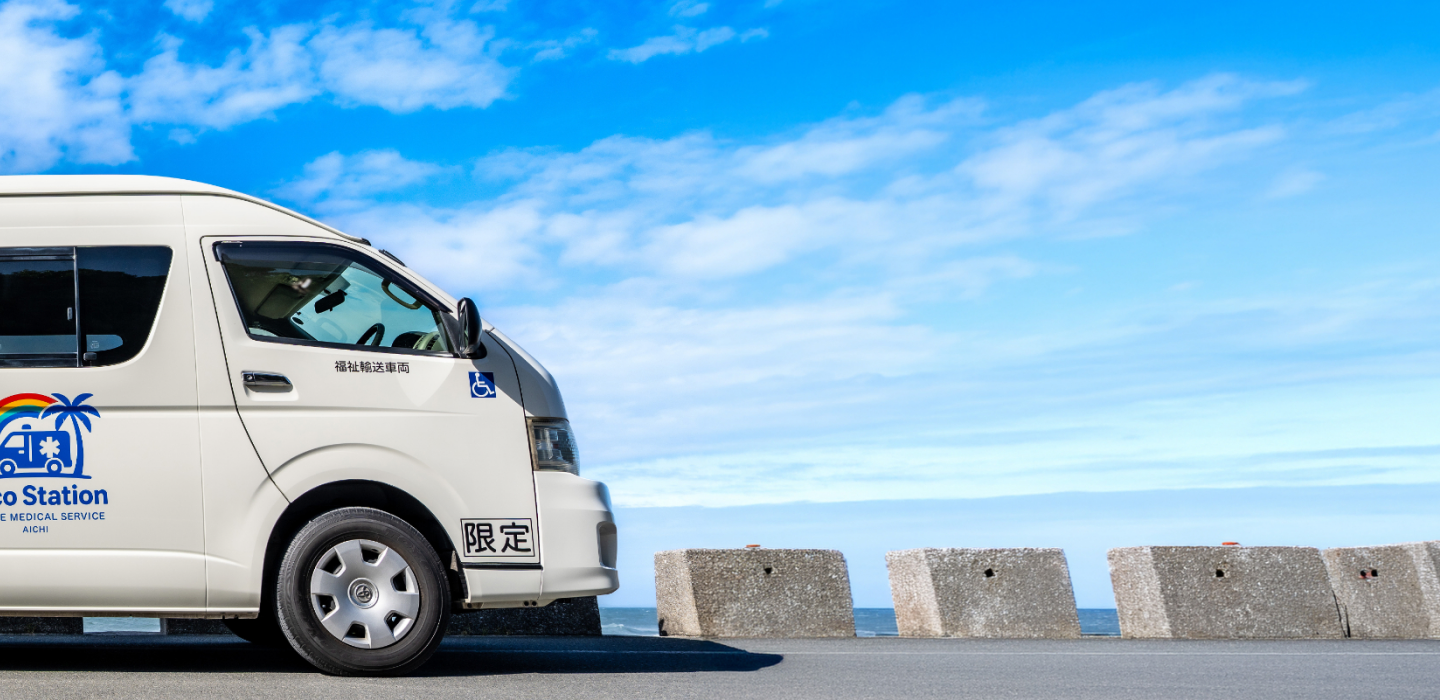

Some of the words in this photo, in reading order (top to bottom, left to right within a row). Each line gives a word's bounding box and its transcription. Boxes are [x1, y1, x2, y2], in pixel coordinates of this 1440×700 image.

[334, 360, 410, 373] 福祉輸送車両
[22, 484, 108, 505] Station
[10, 512, 57, 521] MEDICAL
[61, 512, 105, 520] SERVICE
[464, 522, 531, 553] 限定
